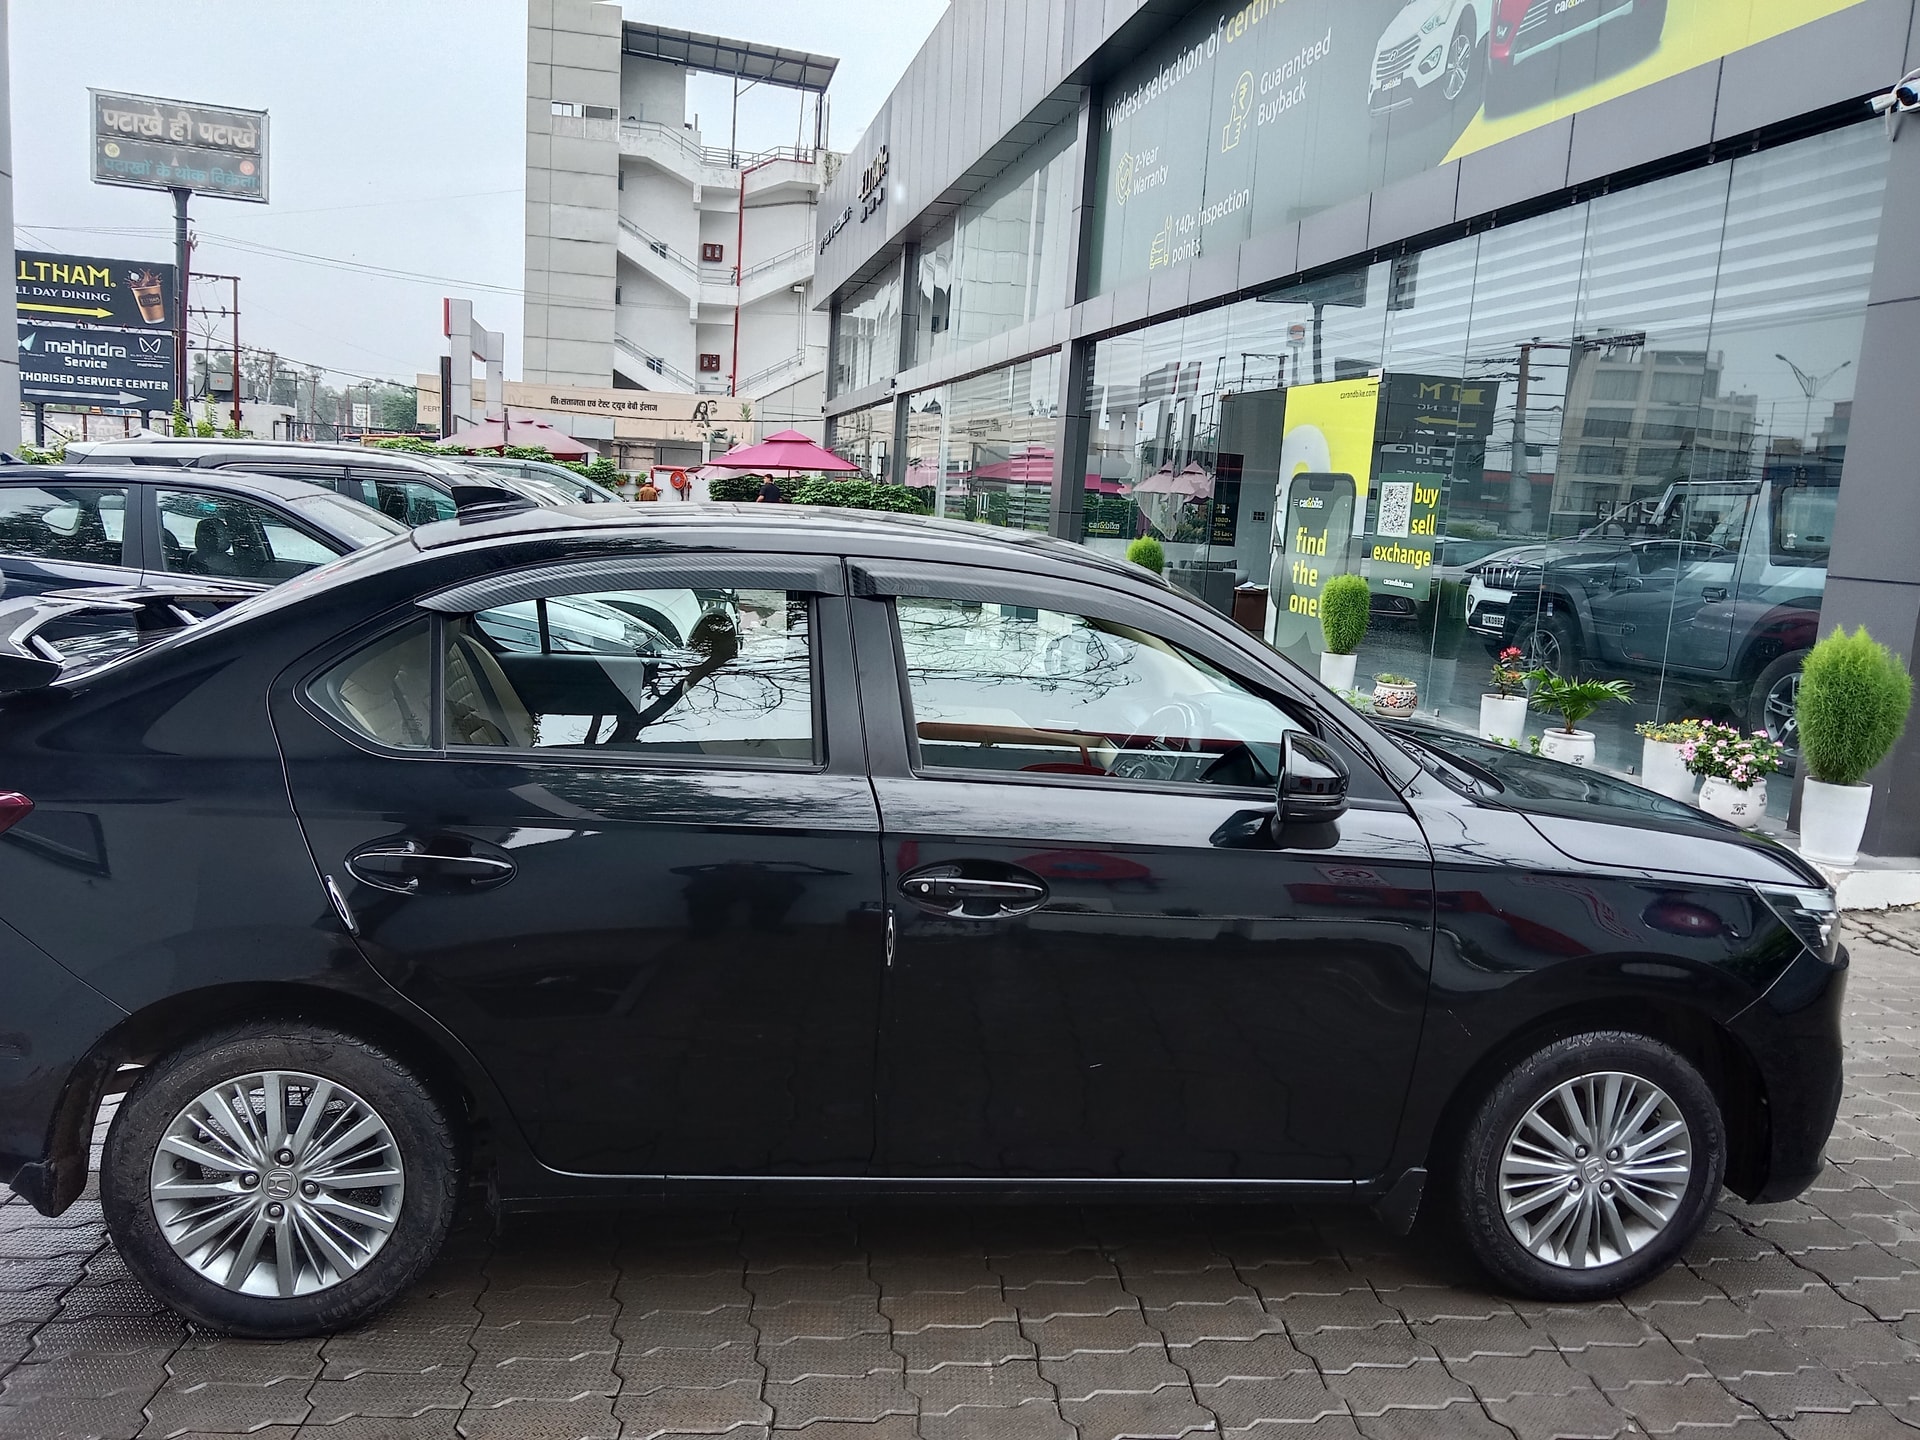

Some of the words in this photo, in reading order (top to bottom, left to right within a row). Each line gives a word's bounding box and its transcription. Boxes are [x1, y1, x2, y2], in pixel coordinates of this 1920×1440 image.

[1105, 87, 1144, 132] Widest
[1144, 42, 1203, 105] selection
[1207, 14, 1226, 61] of
[1226, 0, 1285, 43] certi
[1259, 27, 1332, 95] Guaranteed
[1257, 78, 1308, 127] Buyback
[102, 108, 164, 137] पटाखे
[168, 111, 194, 142] ही
[199, 121, 258, 149] पटाखे
[155, 161, 172, 177] के
[175, 166, 207, 182] थोक
[1134, 147, 1160, 171] 2-Year
[1133, 165, 1169, 196] Warranty
[1174, 215, 1195, 237] 140+
[1197, 188, 1250, 228] inspection
[1171, 236, 1201, 268] points
[33, 287, 58, 298] DAY
[61, 289, 111, 302] DINING
[44, 339, 127, 358] mahindra
[64, 356, 108, 369] Service
[19, 372, 75, 384] THORISED
[76, 375, 123, 388] SERVICE
[125, 379, 169, 391] CENTER
[1414, 482, 1439, 509] buy
[1411, 513, 1435, 536] sell
[1295, 526, 1328, 557] find
[1373, 541, 1431, 570] exchange
[1292, 559, 1318, 588] the
